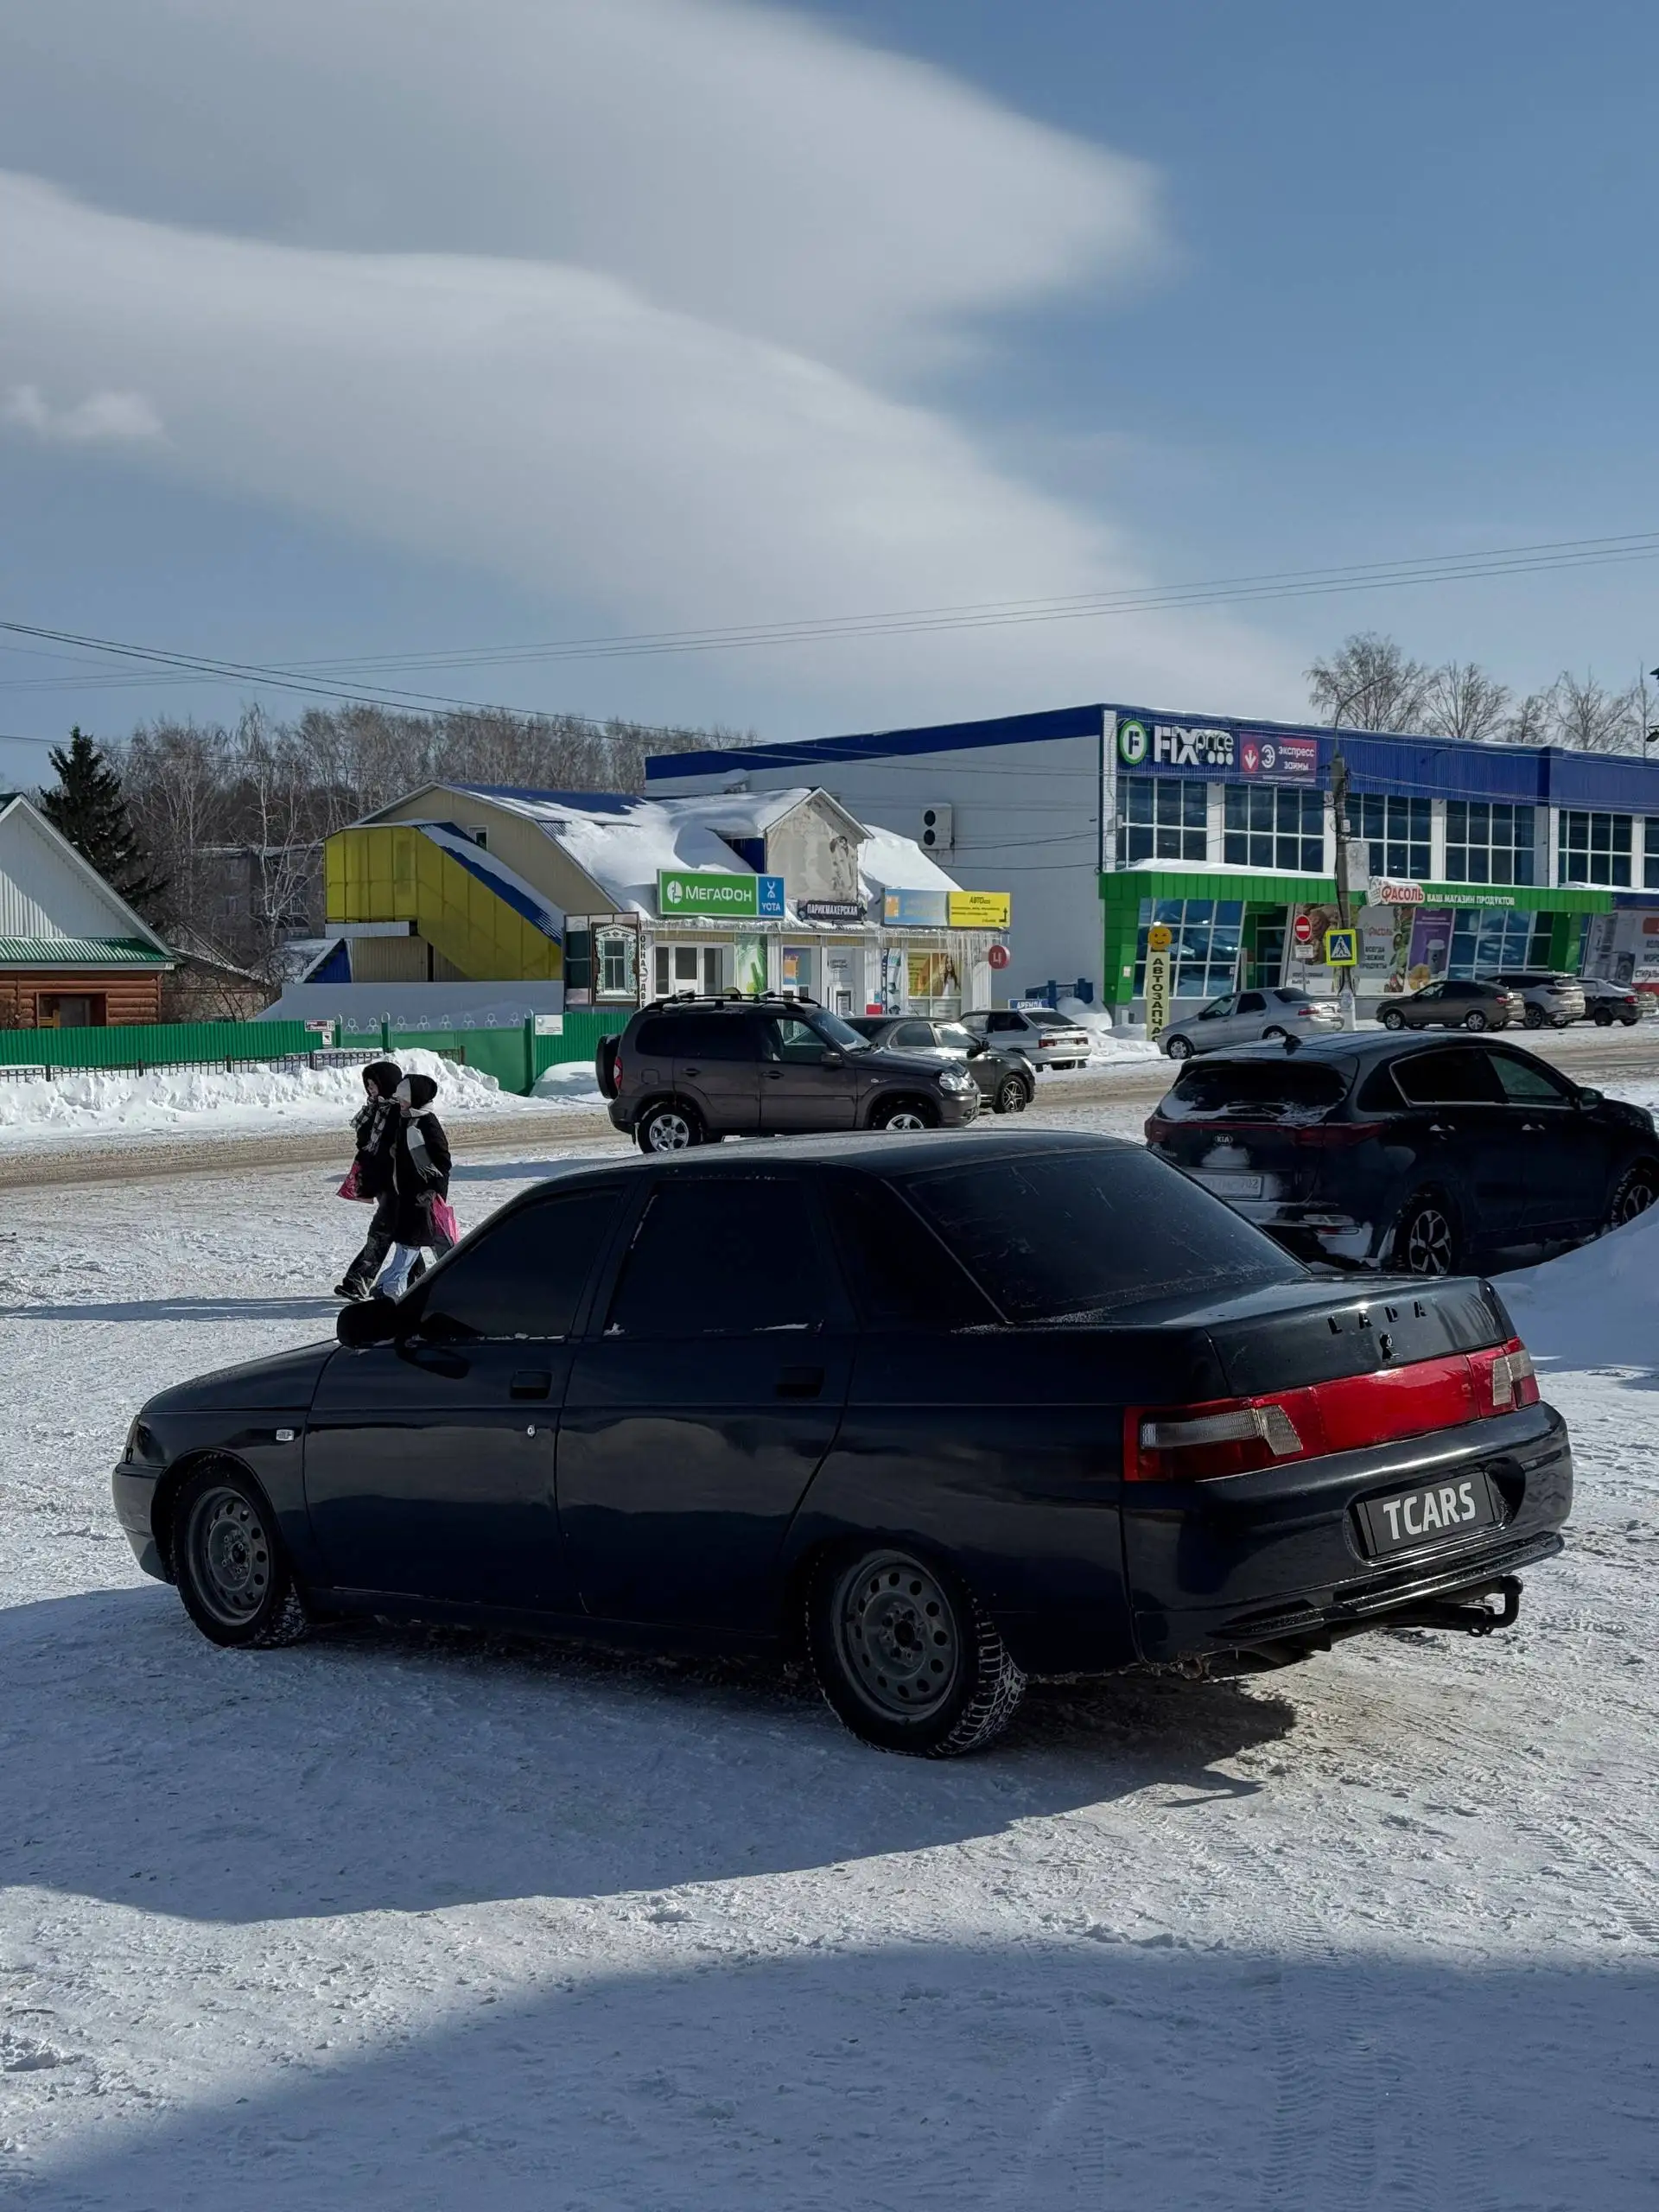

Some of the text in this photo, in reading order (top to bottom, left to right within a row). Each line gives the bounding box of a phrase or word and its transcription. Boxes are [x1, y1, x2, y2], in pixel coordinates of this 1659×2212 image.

[1427, 893, 1515, 906] ВАШ МАГАЗИН ПРОДУКТОВ
[761, 902, 781, 912] YOTA
[806, 903, 858, 916] ПАРИКМАХЕРСКАЯ
[1327, 1300, 1428, 1335] LADA
[1382, 1482, 1476, 1540] TCARS
